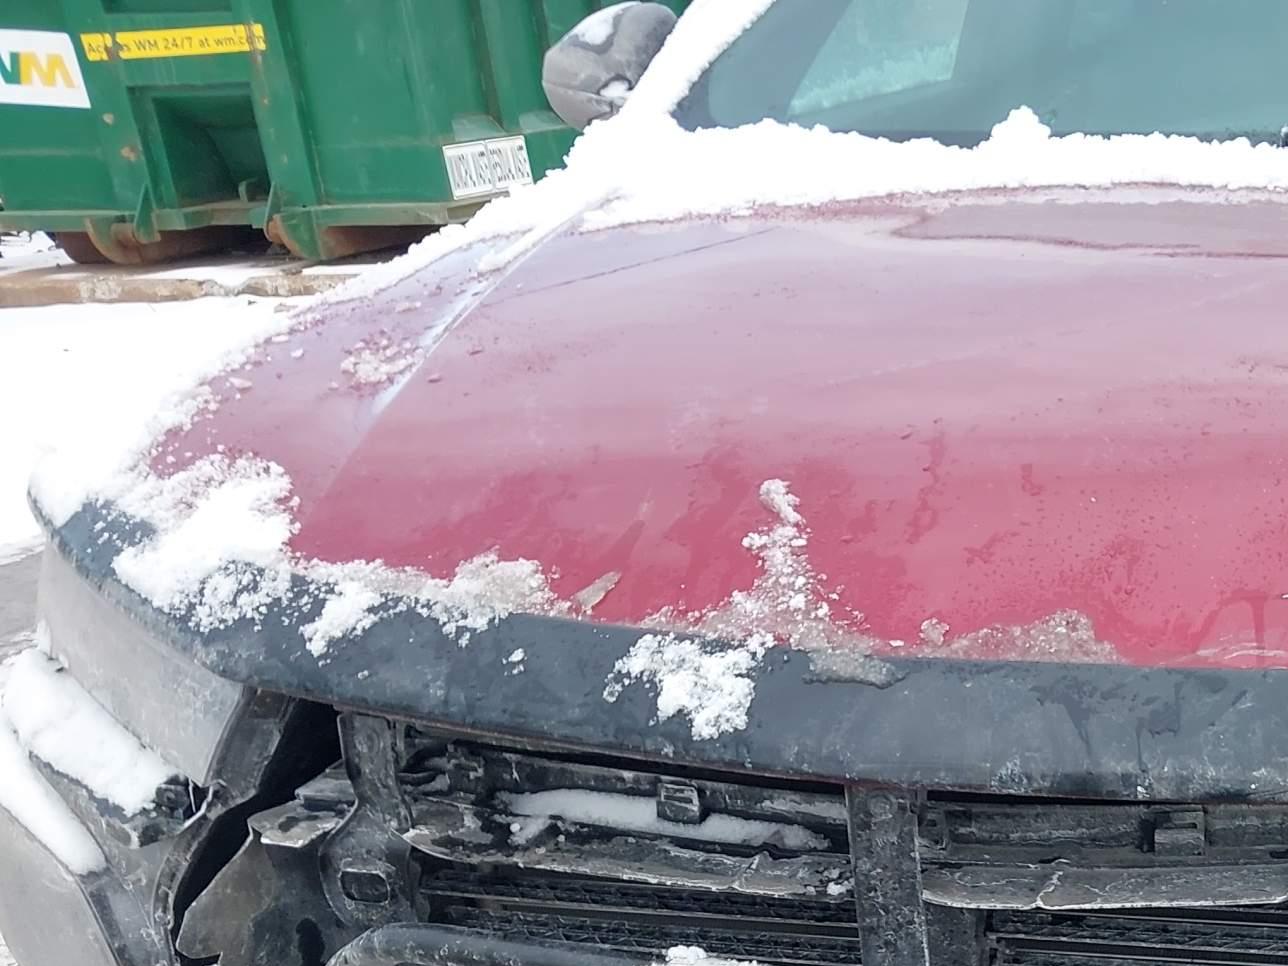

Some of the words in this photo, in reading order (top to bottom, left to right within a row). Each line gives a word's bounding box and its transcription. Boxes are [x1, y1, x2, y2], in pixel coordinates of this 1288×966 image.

[134, 40, 159, 52] WM
[163, 37, 193, 50] 24/7
[199, 37, 210, 49] at
